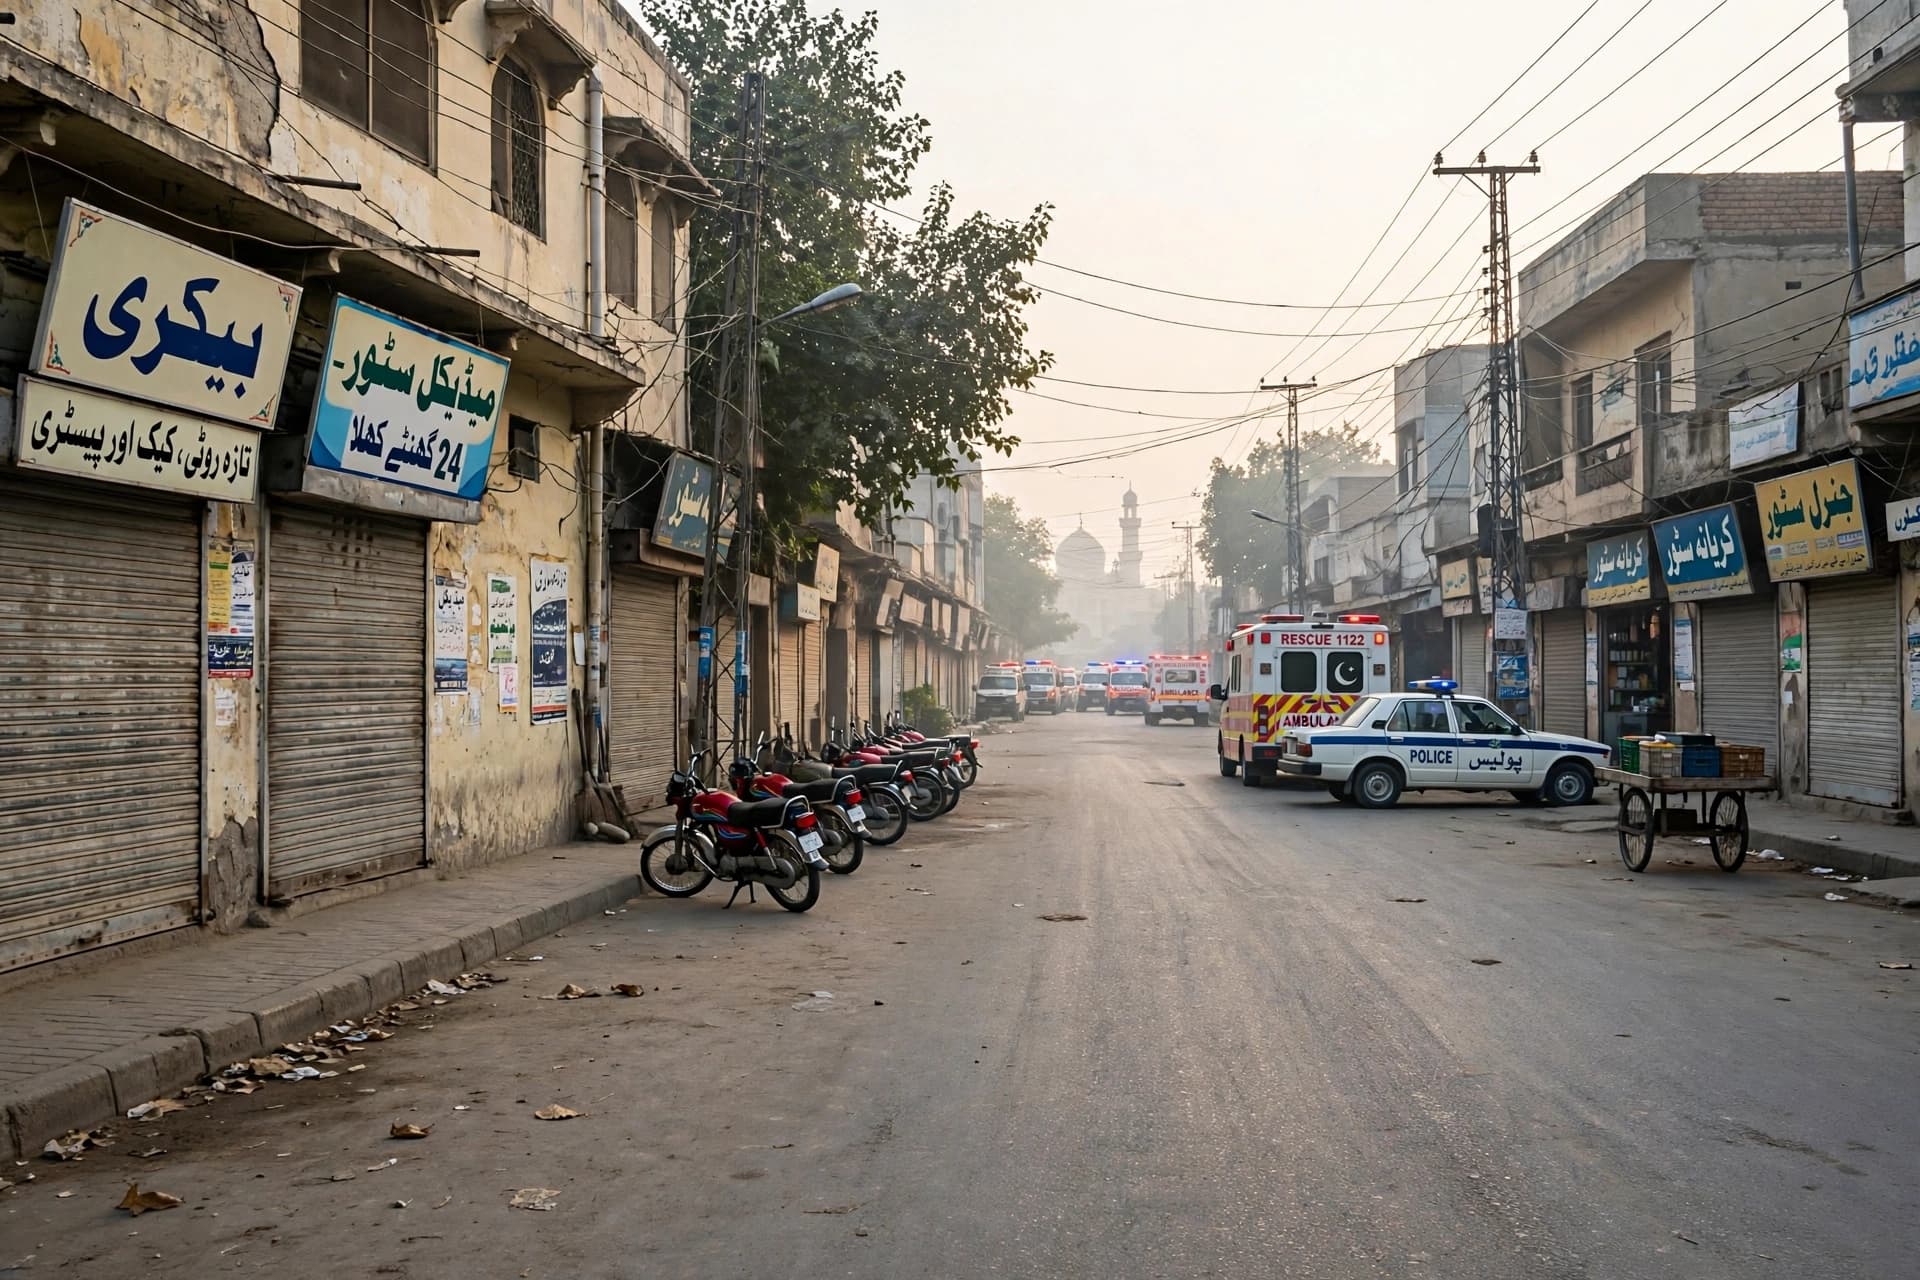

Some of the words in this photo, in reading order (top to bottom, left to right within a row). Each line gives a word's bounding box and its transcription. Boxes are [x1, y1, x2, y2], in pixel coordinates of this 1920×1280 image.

[83, 276, 263, 398] بیکری
[417, 354, 495, 427] میڈیکل
[31, 400, 105, 470] پیسٹری
[104, 419, 135, 465] اور
[137, 421, 177, 473] کیک
[350, 415, 389, 457] کھلا
[384, 426, 440, 473] گھنٹے
[222, 444, 252, 483] تازہ
[434, 439, 463, 482] 24
[1767, 485, 1805, 540] سٹور
[1809, 477, 1853, 530] جنرل
[1616, 537, 1643, 576] کریانہ
[1667, 525, 1694, 577] سٹور
[1696, 514, 1735, 568] کریانہ
[1281, 634, 1332, 645] RESCUE
[1336, 634, 1365, 646] 1122
[1410, 750, 1453, 764] POLICE
[1469, 750, 1522, 774] پولیس
